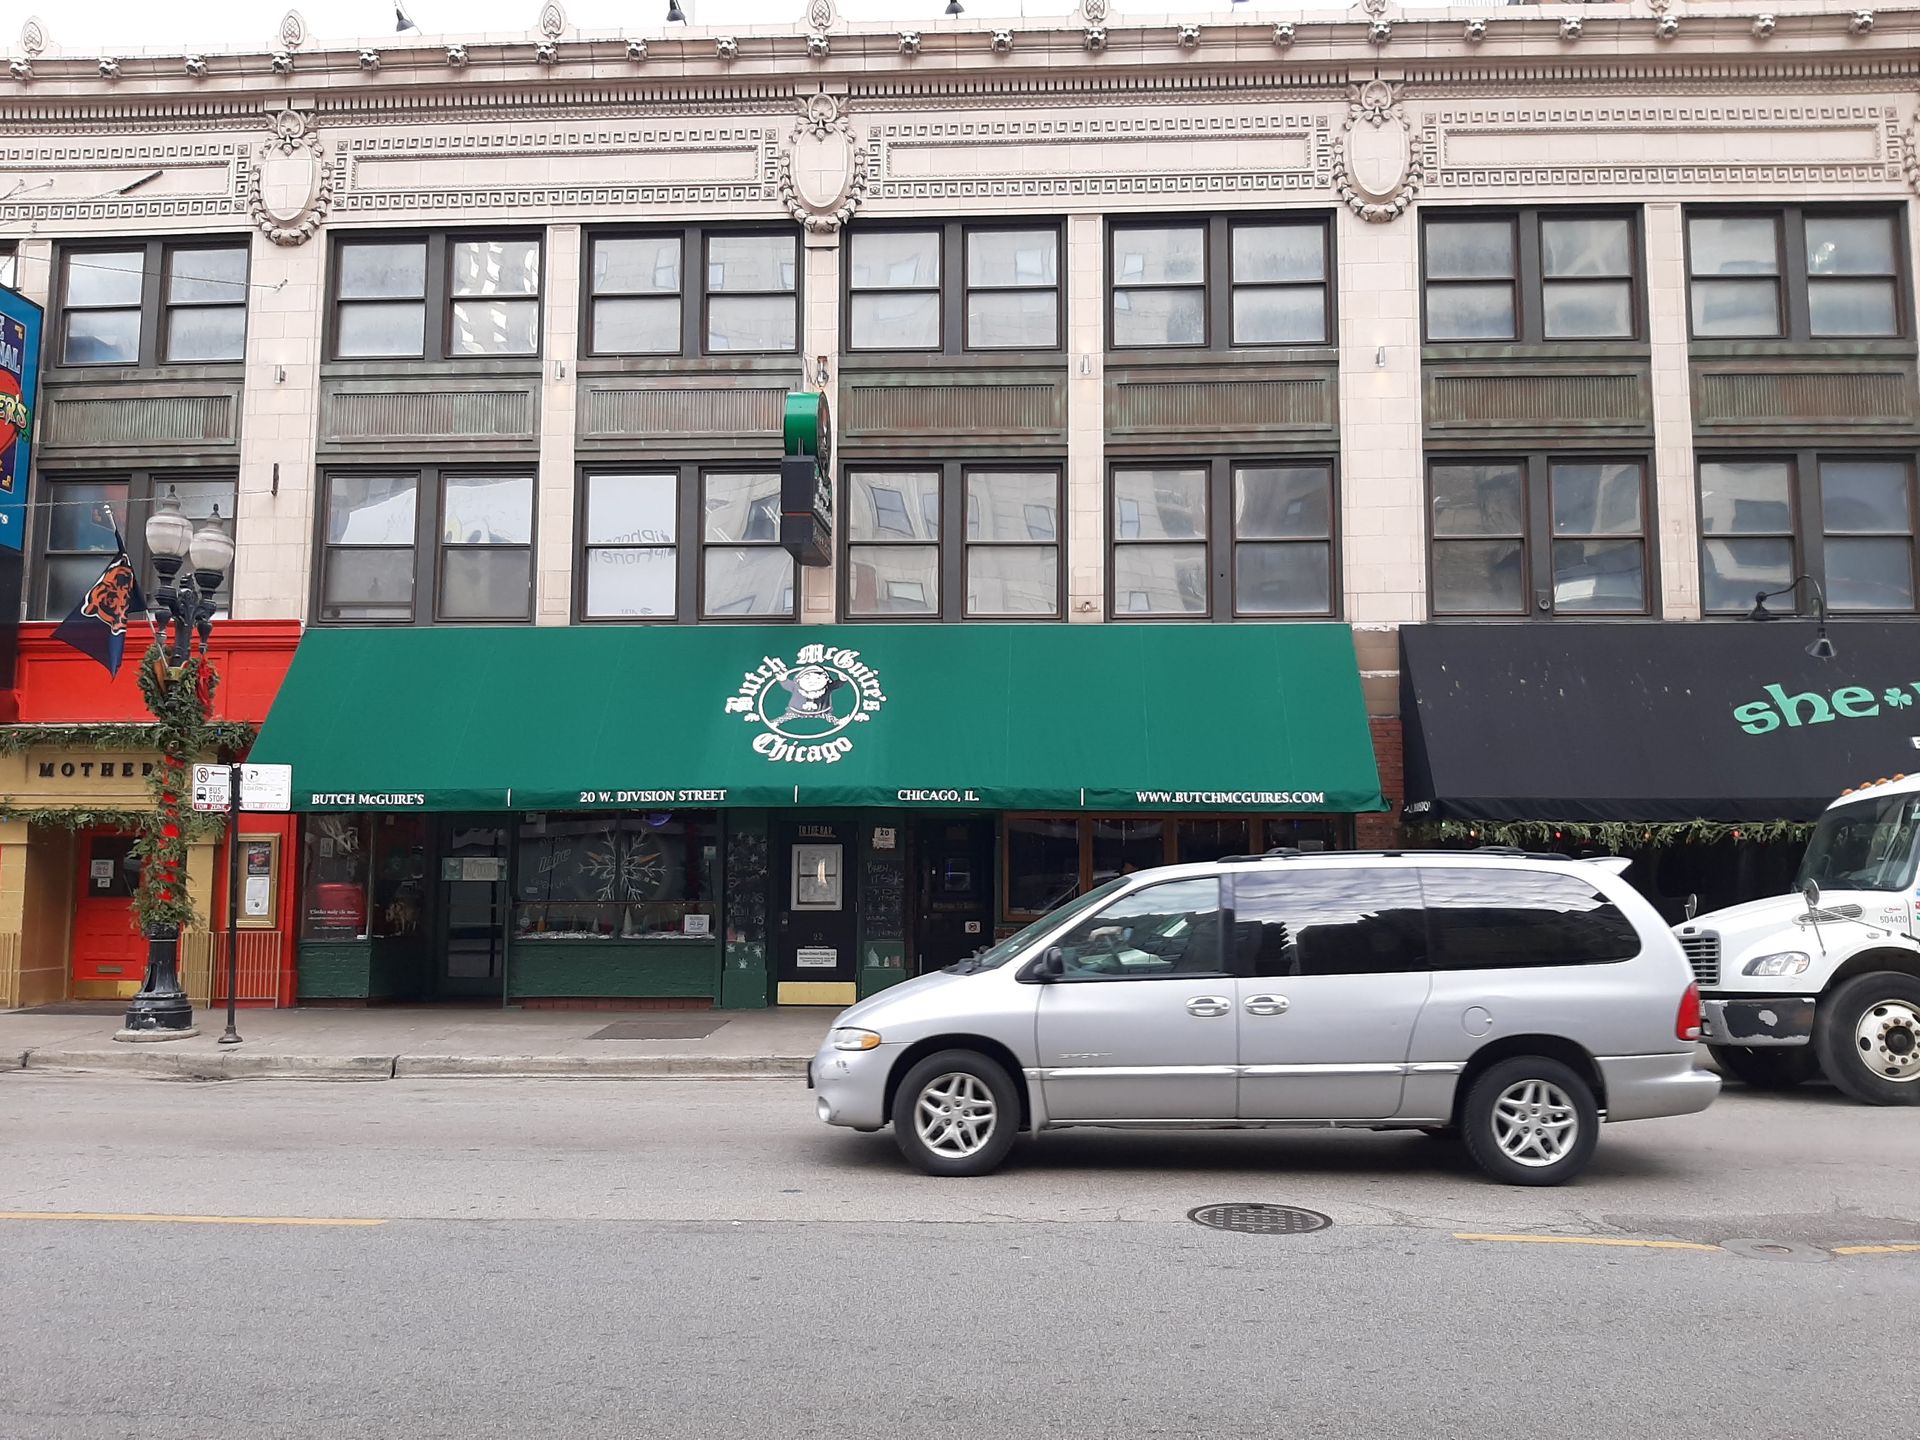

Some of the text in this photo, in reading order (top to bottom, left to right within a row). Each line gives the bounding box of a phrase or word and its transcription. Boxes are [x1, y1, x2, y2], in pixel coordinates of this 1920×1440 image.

[725, 655, 789, 715] Butch
[752, 731, 854, 764] Chicago
[311, 793, 356, 805] BUTCH
[579, 789, 727, 803] 20 W. DIVISION STREET
[897, 789, 961, 802] CHICAGO,
[1135, 791, 1324, 804] WWW.BUTCHMCGUIRES.COM
